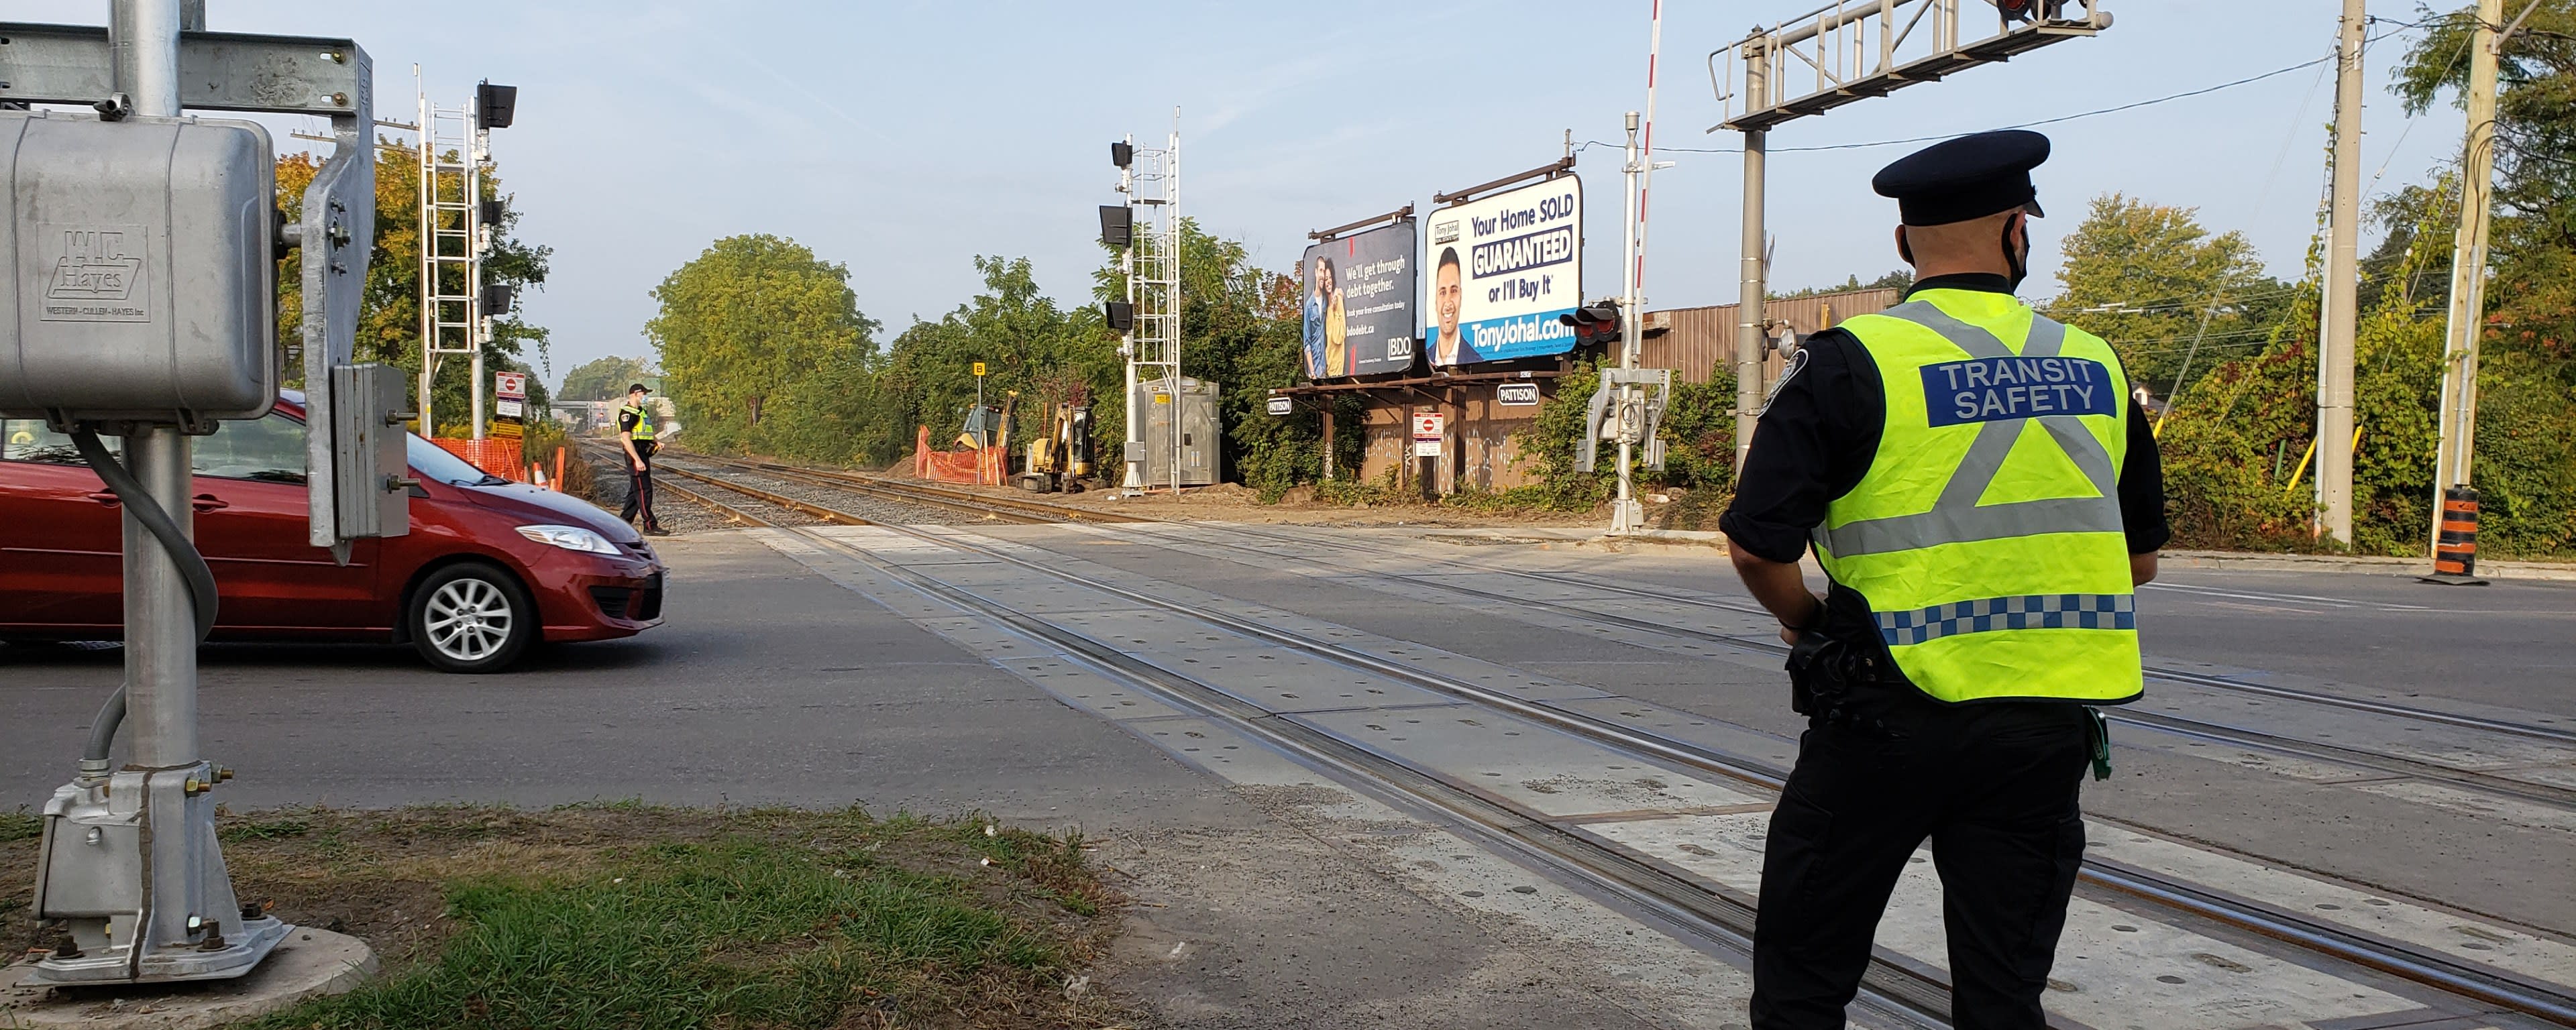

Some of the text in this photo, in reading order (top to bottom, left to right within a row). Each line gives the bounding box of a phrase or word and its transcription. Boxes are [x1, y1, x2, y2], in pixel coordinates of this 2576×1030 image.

[1472, 194, 1573, 238] Your Home SOLD
[1436, 226, 1446, 236] Tony
[1474, 229, 1571, 276] GUARANTEED
[1346, 255, 1405, 281] We'll get through
[60, 269, 121, 291] Hayes
[1346, 278, 1394, 298] debt together.
[1489, 287, 1500, 302] or
[1503, 279, 1515, 300] I'll
[1519, 278, 1539, 302] Buy
[1346, 308, 1355, 317] Book
[1355, 309, 1364, 318] your
[1373, 302, 1394, 312] consultation
[1394, 300, 1405, 310] today
[1346, 324, 1374, 337] bdodebt.ca
[1391, 337, 1411, 355] BDO
[1939, 359, 2091, 390] TRANSIT
[1500, 388, 1536, 400] PATTISON
[1954, 385, 2094, 419] SAFETY
[1269, 401, 1289, 410] PATTISON
